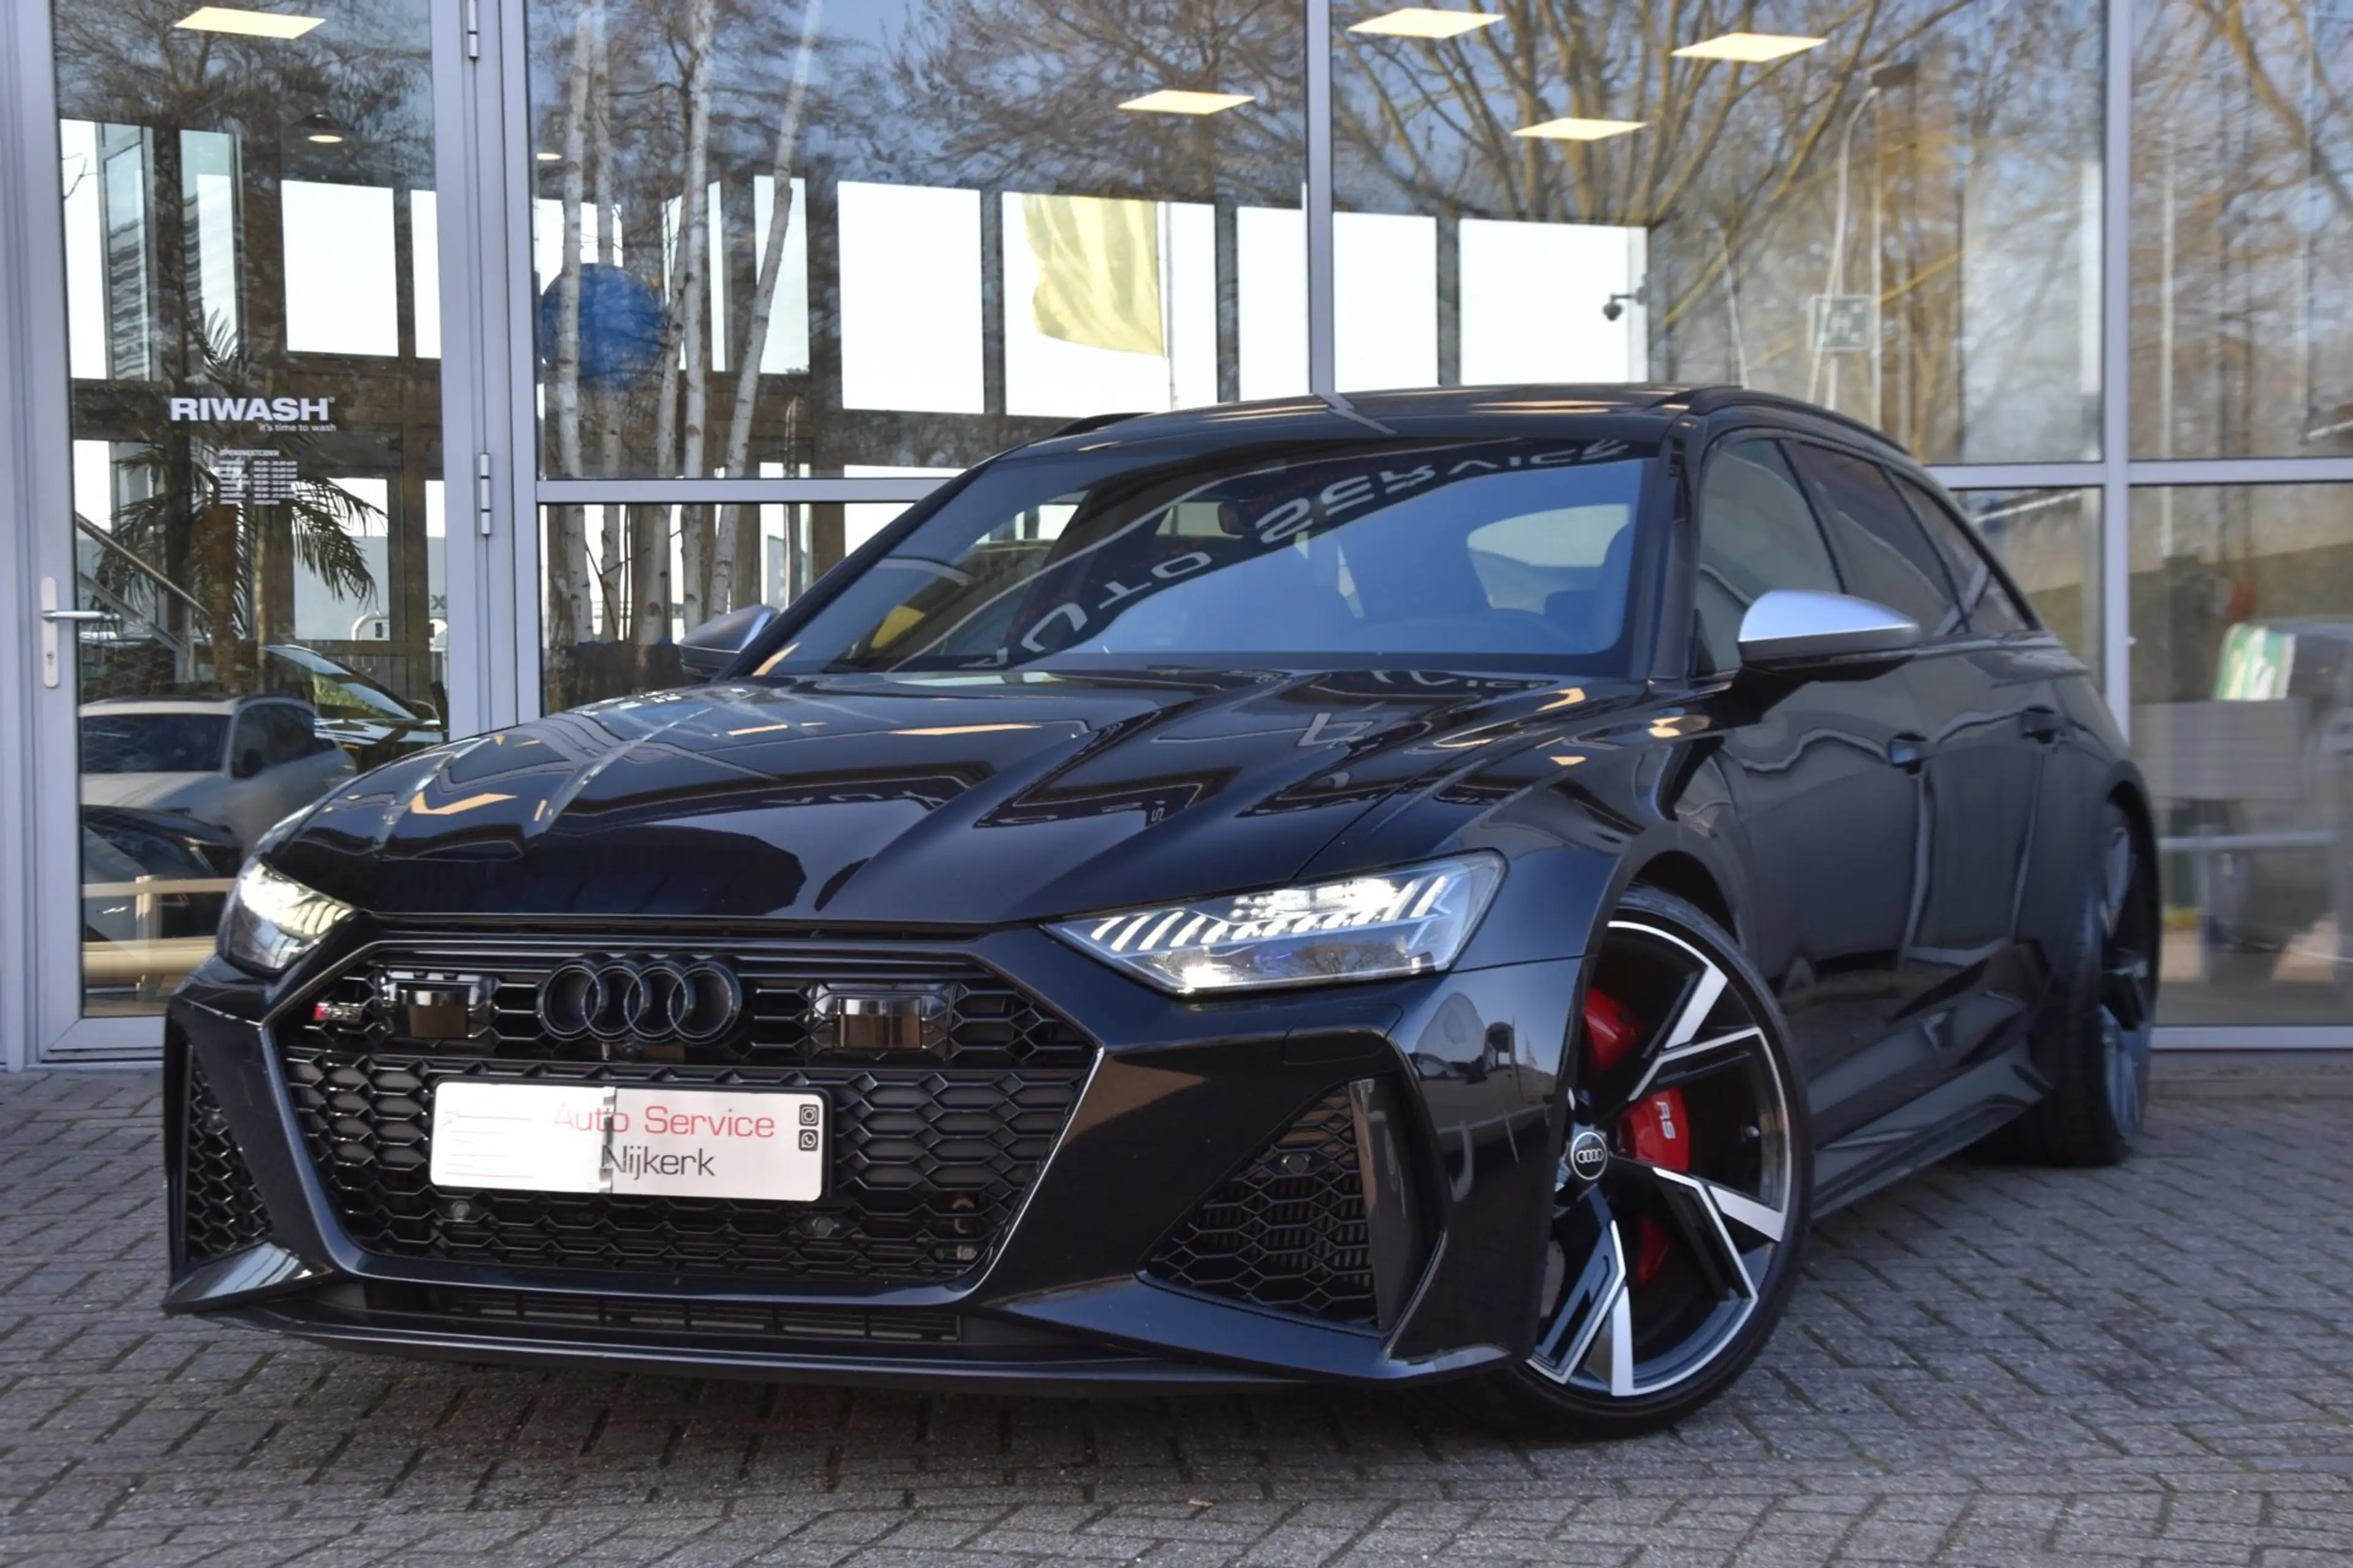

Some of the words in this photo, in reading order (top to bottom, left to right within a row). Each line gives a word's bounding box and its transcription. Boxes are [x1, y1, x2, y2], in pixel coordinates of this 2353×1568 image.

[171, 397, 329, 422] RIWASH
[311, 423, 336, 432] wash
[554, 1102, 629, 1133] Auto
[645, 1105, 776, 1138] Service
[601, 1144, 716, 1180] Nijkerk
